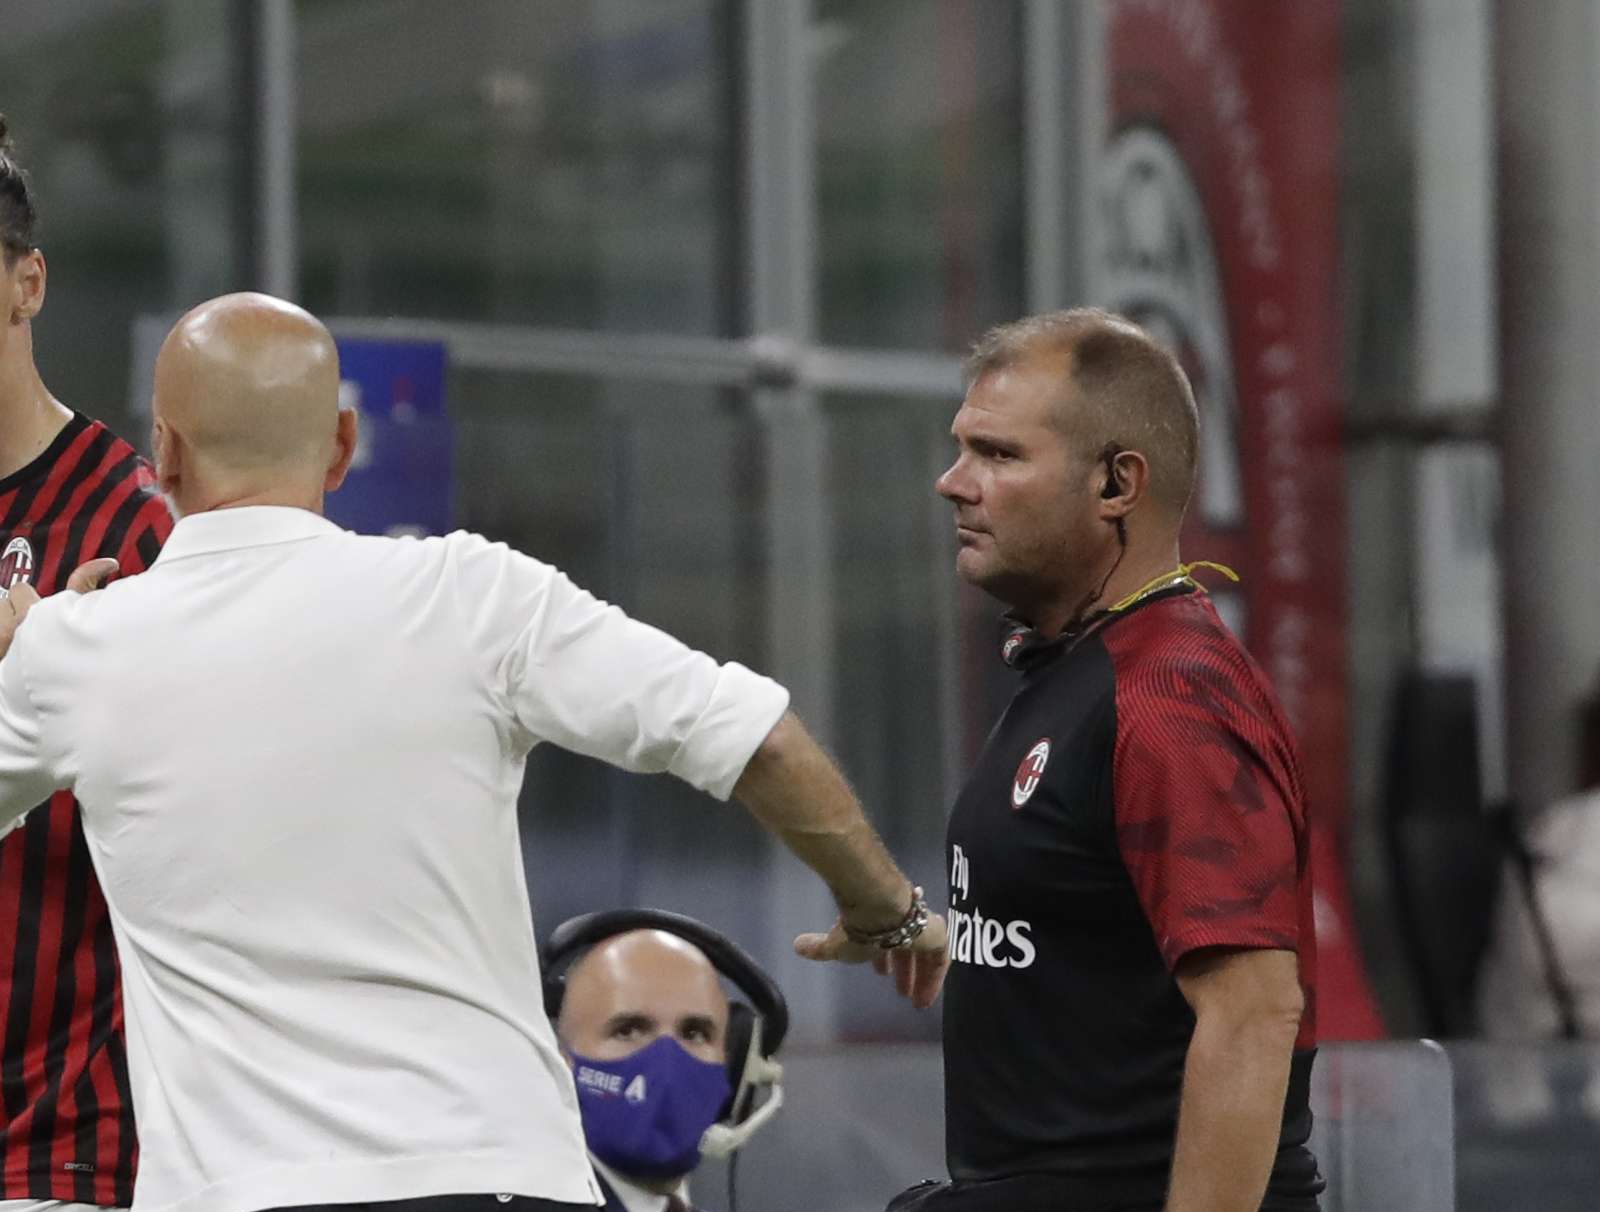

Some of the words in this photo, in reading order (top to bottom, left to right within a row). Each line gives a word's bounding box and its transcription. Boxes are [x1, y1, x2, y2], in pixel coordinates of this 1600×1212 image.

[947, 894, 1036, 968] irates
[578, 1066, 623, 1093] SERIE
[624, 1074, 646, 1102] A
